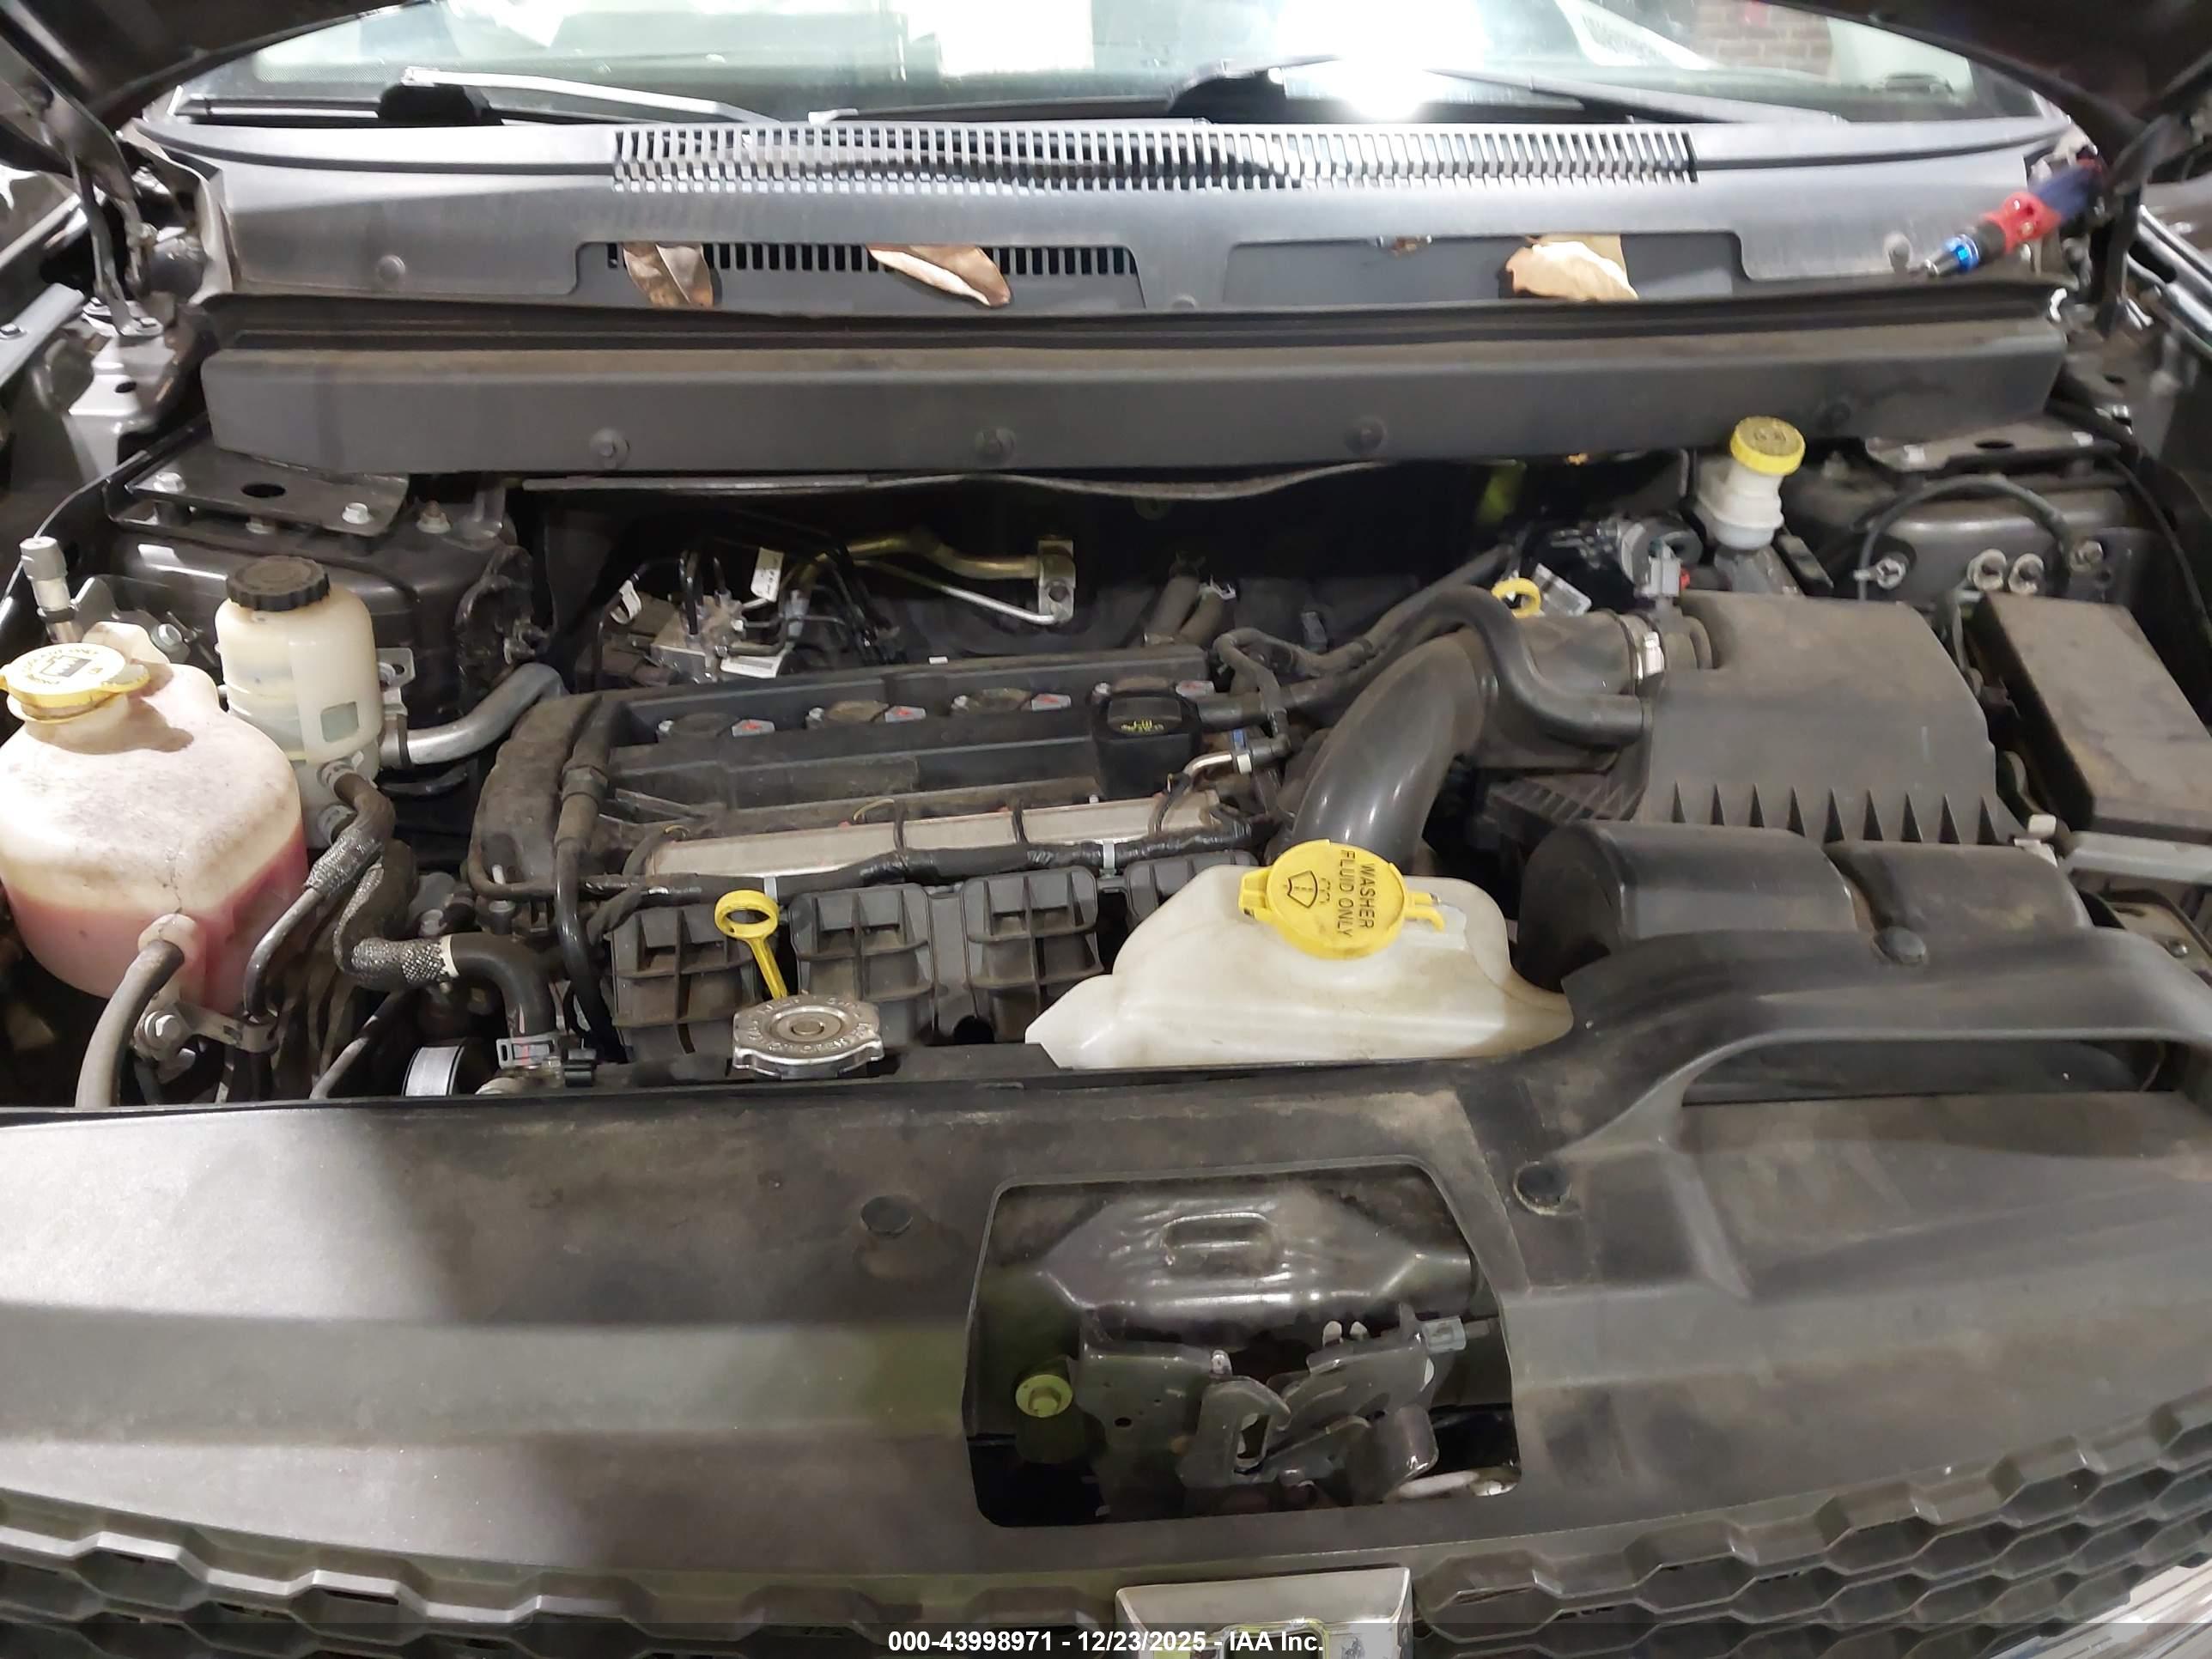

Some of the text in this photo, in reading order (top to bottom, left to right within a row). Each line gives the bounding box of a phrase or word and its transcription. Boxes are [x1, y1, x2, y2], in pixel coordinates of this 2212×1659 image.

[1337, 849, 1356, 938] FLUID ONLY
[1359, 863, 1376, 928] WASHER
